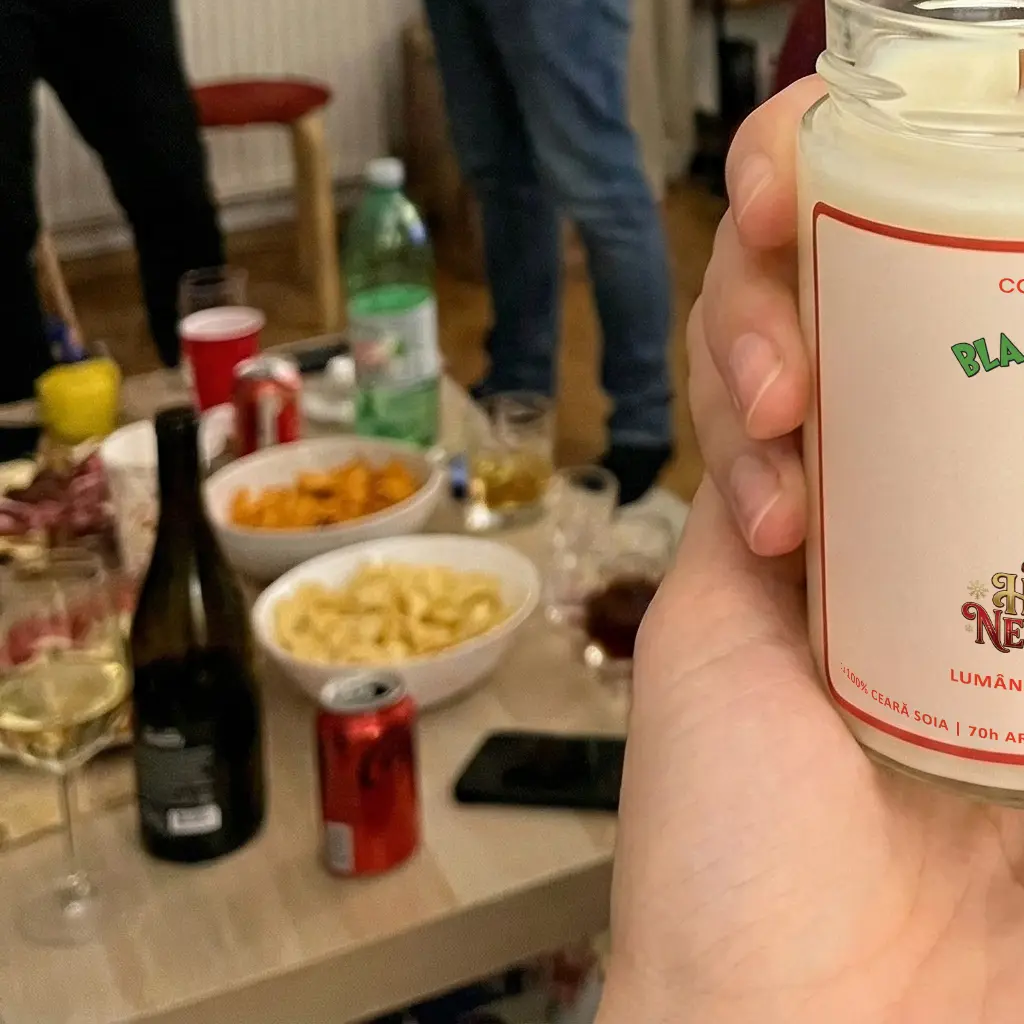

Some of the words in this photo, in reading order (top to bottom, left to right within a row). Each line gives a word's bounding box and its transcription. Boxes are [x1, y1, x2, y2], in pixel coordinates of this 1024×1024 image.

[871, 689, 910, 718] CEARĂ
[914, 710, 949, 731] SOIA
[968, 725, 999, 741] 70h
